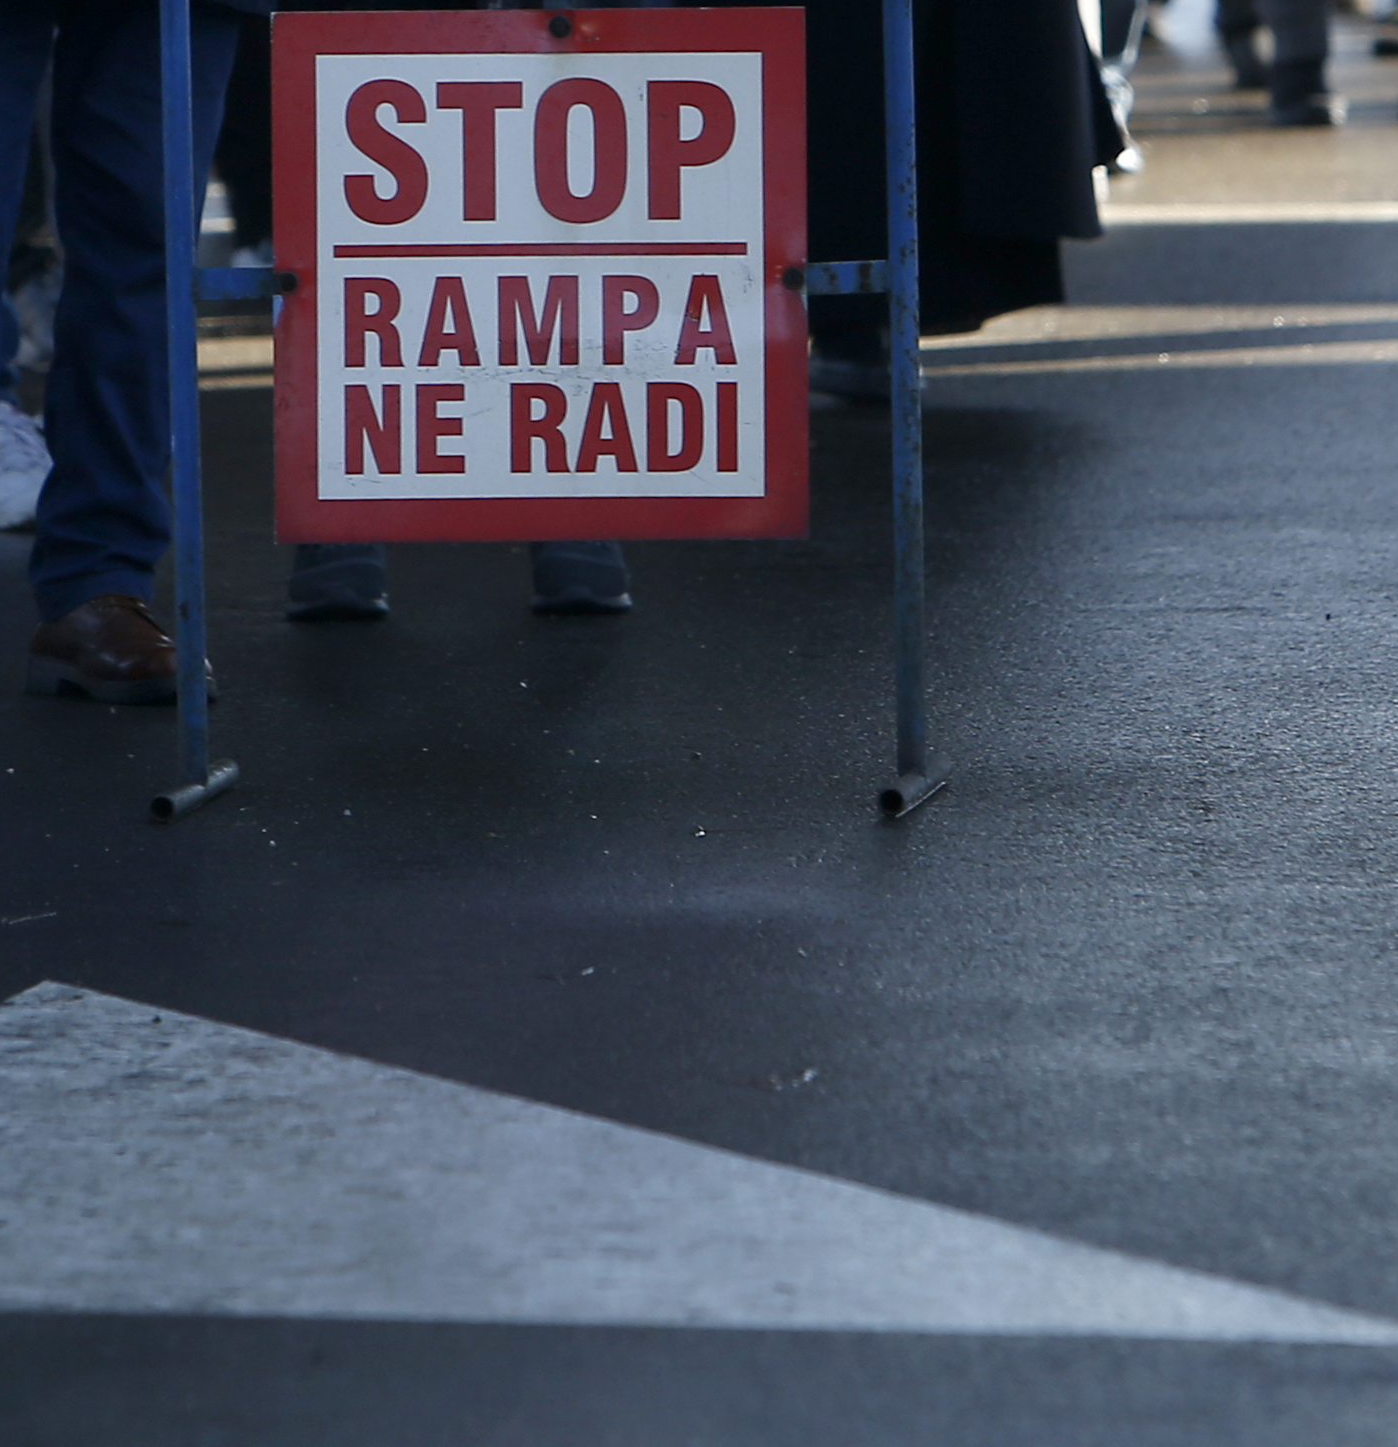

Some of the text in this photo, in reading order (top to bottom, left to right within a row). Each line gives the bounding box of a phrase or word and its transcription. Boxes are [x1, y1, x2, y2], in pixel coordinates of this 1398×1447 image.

[344, 78, 736, 225] STOP
[344, 275, 737, 367] RAMPA
[344, 382, 738, 474] NE RADI
